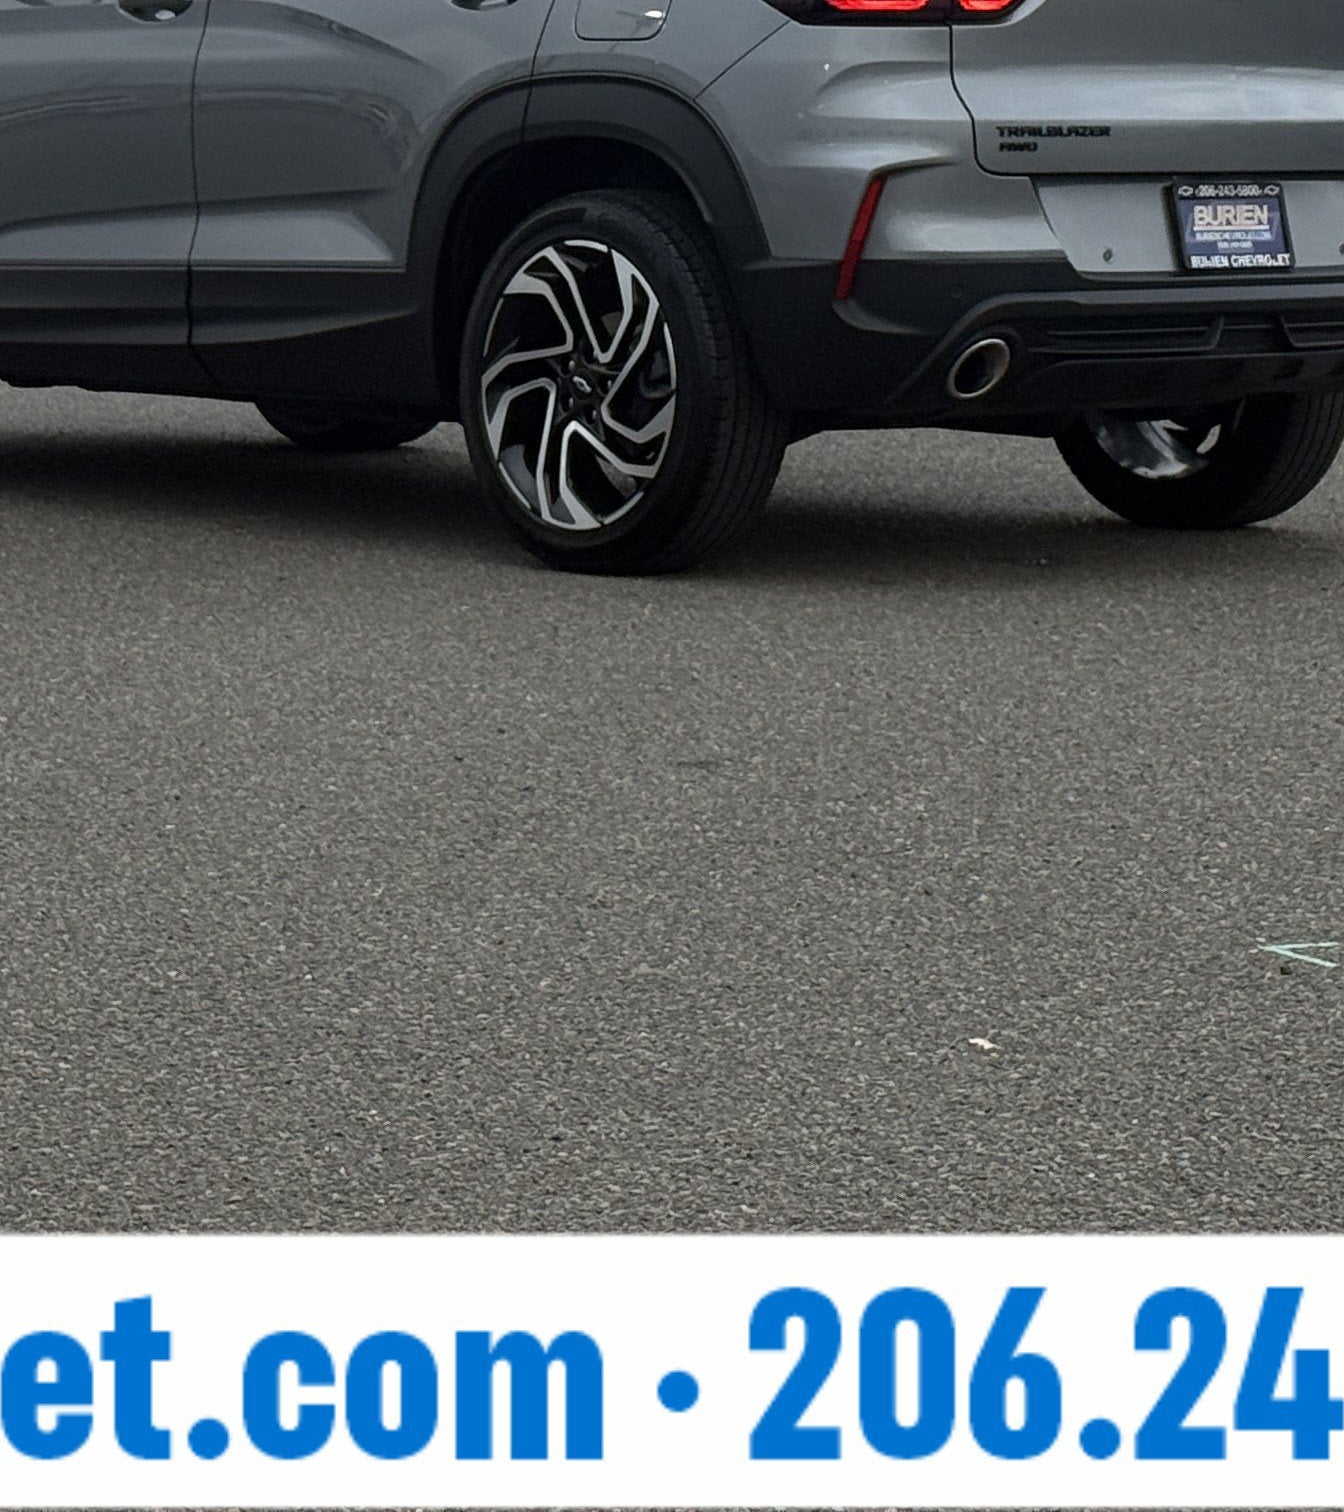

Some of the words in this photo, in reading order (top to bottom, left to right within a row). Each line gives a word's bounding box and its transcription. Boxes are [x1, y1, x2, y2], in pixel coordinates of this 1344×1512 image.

[995, 125, 1112, 138] TRAILBLAZER
[1193, 204, 1269, 226] BURIEN
[1230, 252, 1291, 268] CHEVROLET
